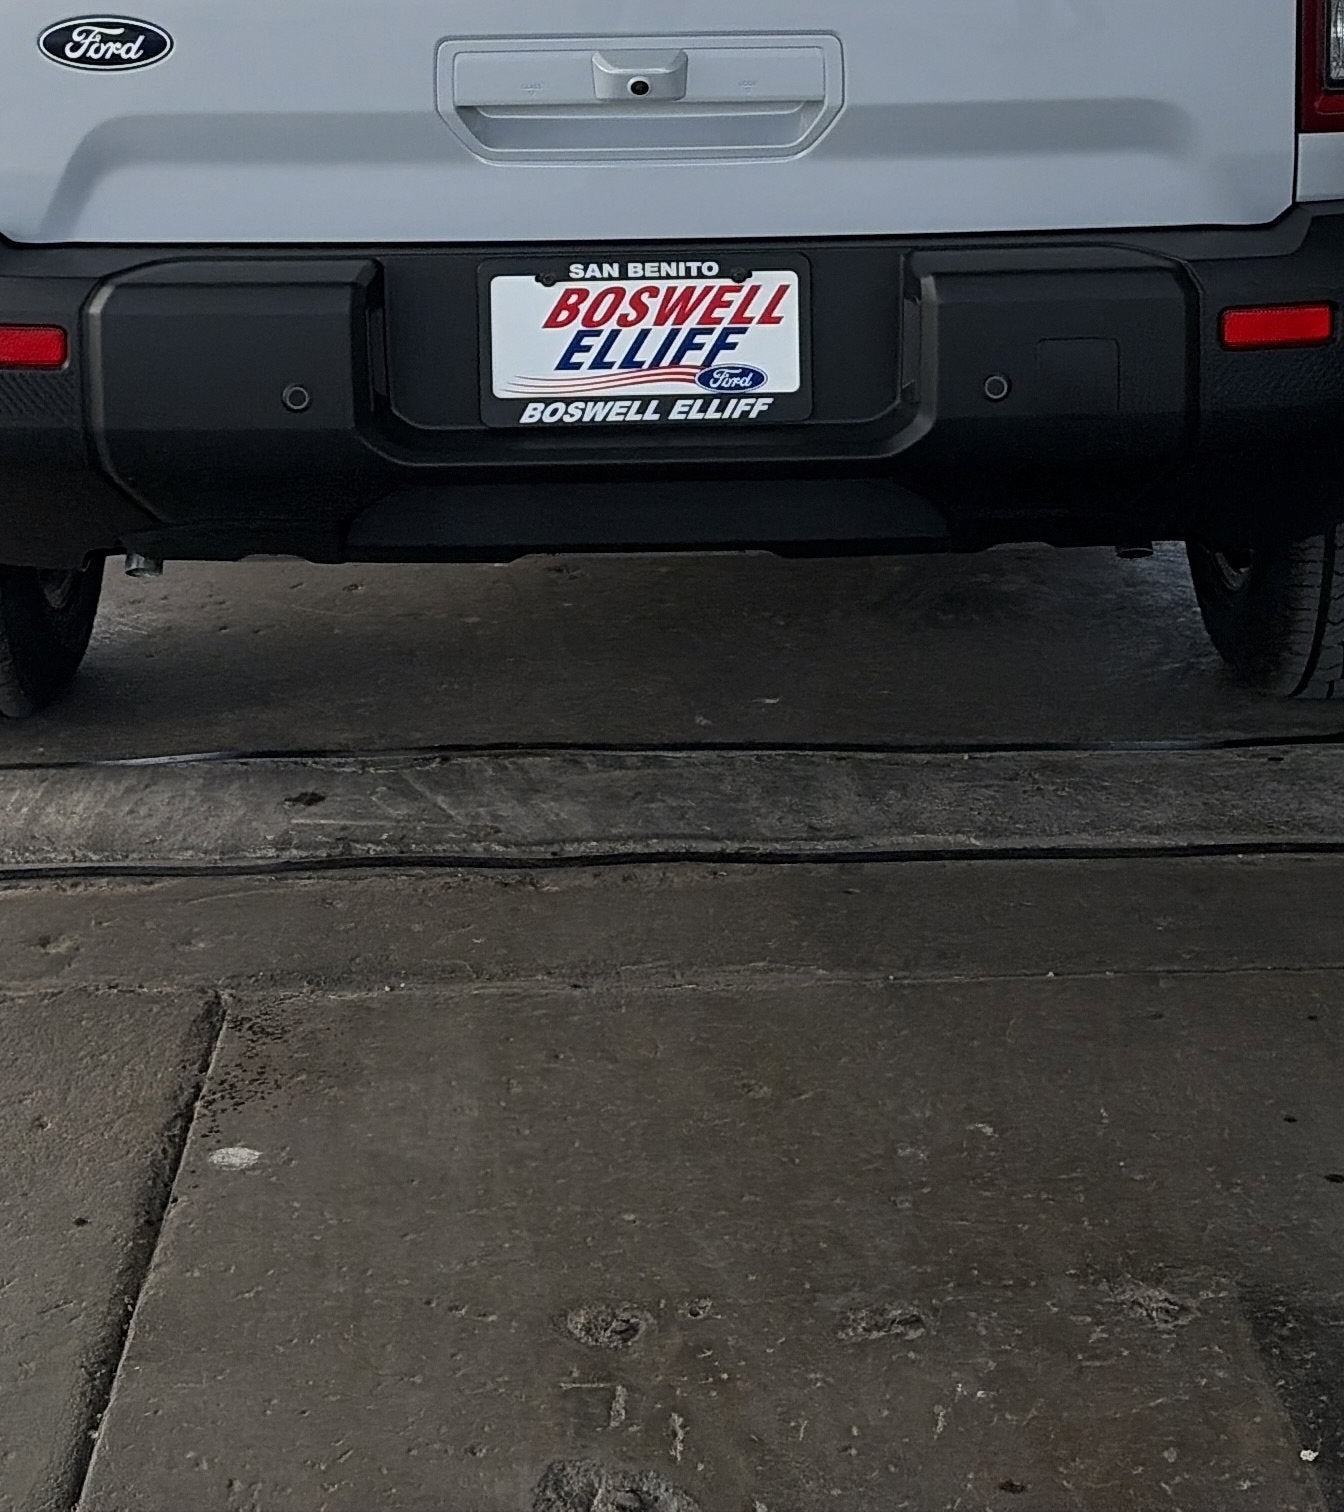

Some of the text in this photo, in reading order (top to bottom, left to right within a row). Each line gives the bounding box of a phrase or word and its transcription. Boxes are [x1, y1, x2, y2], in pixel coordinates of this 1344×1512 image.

[64, 25, 146, 60] Ford
[568, 261, 720, 279] SAN BENITO
[542, 284, 792, 329] BOSWELL
[554, 326, 751, 371] ELLIFF
[519, 397, 775, 424] BOSWELL ELLIFF
